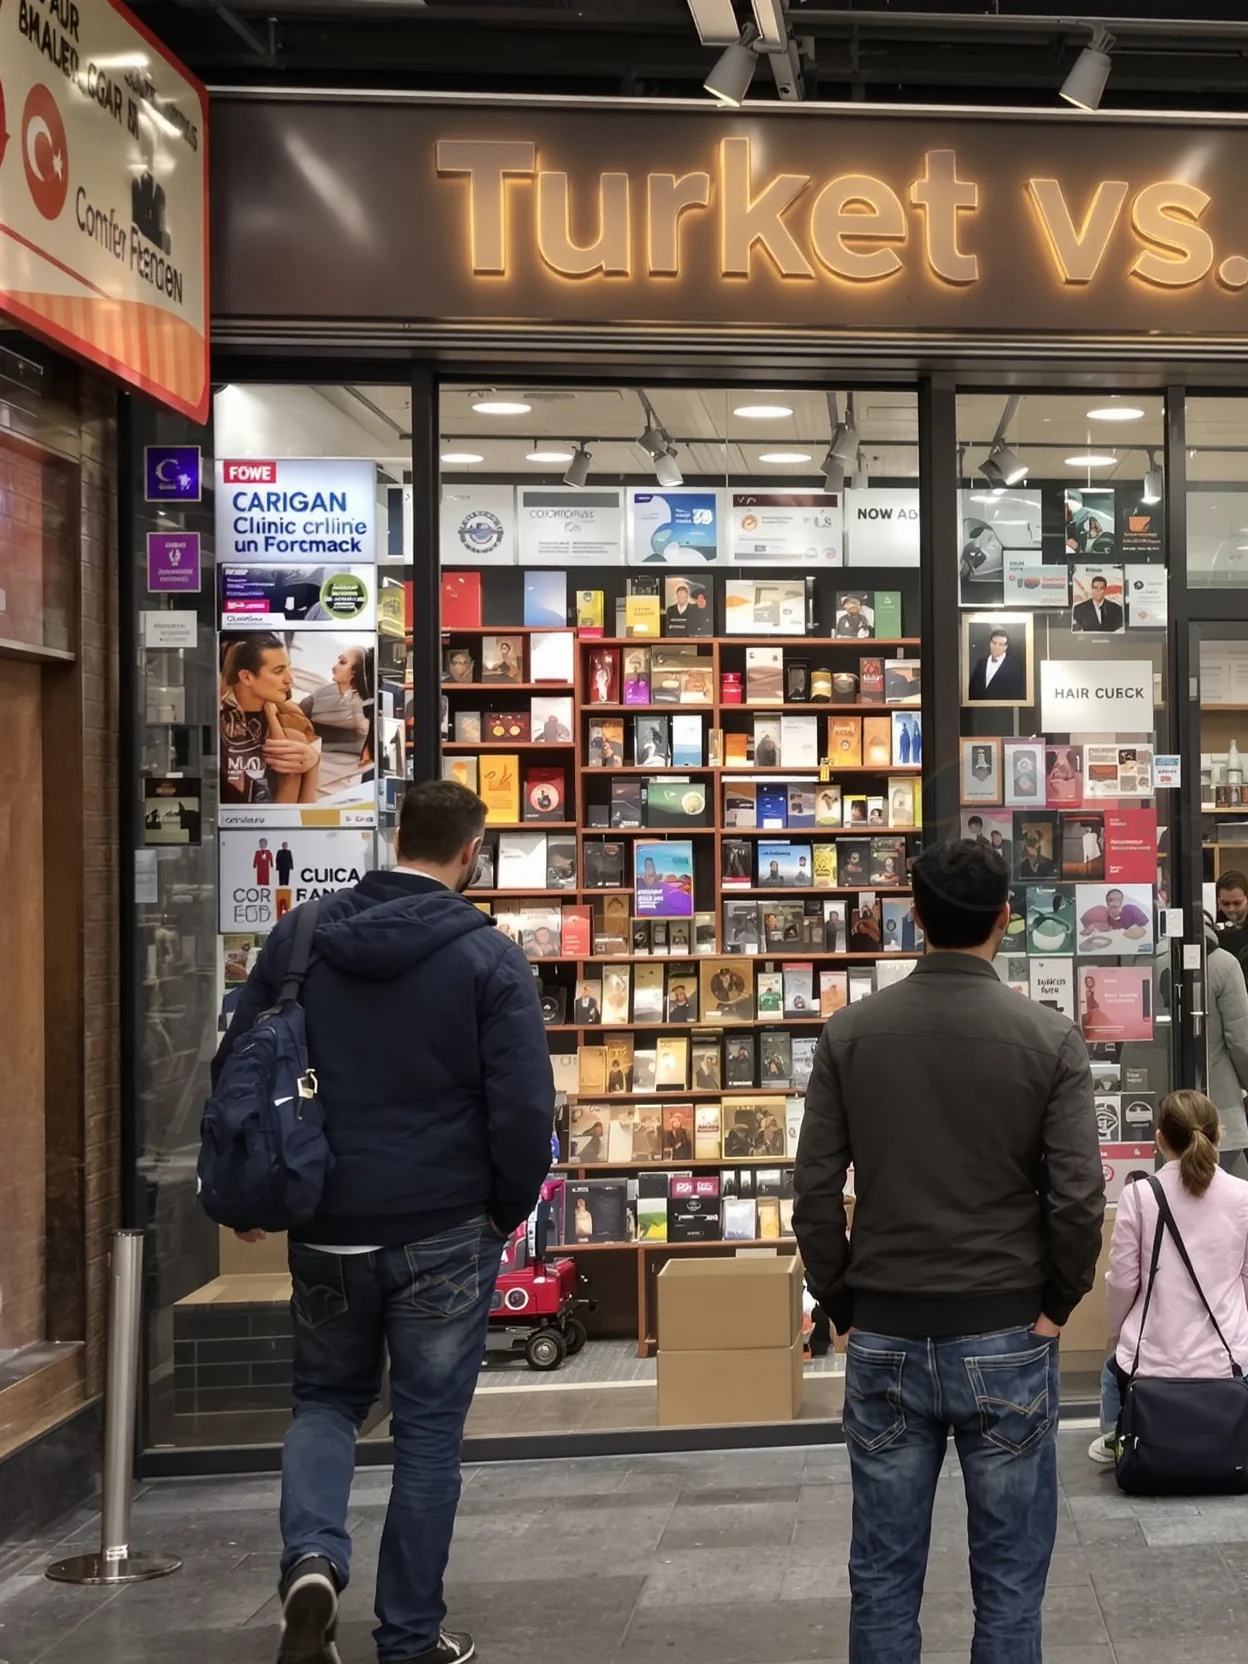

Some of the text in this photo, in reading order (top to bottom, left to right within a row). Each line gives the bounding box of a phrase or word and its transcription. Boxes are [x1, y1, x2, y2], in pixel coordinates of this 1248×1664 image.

[436, 136, 979, 285] Turket
[232, 491, 347, 513] CARIGAN
[857, 507, 893, 520] NOW
[234, 540, 259, 553] un
[1055, 687, 1090, 699] HAIR
[232, 888, 272, 903] COR
